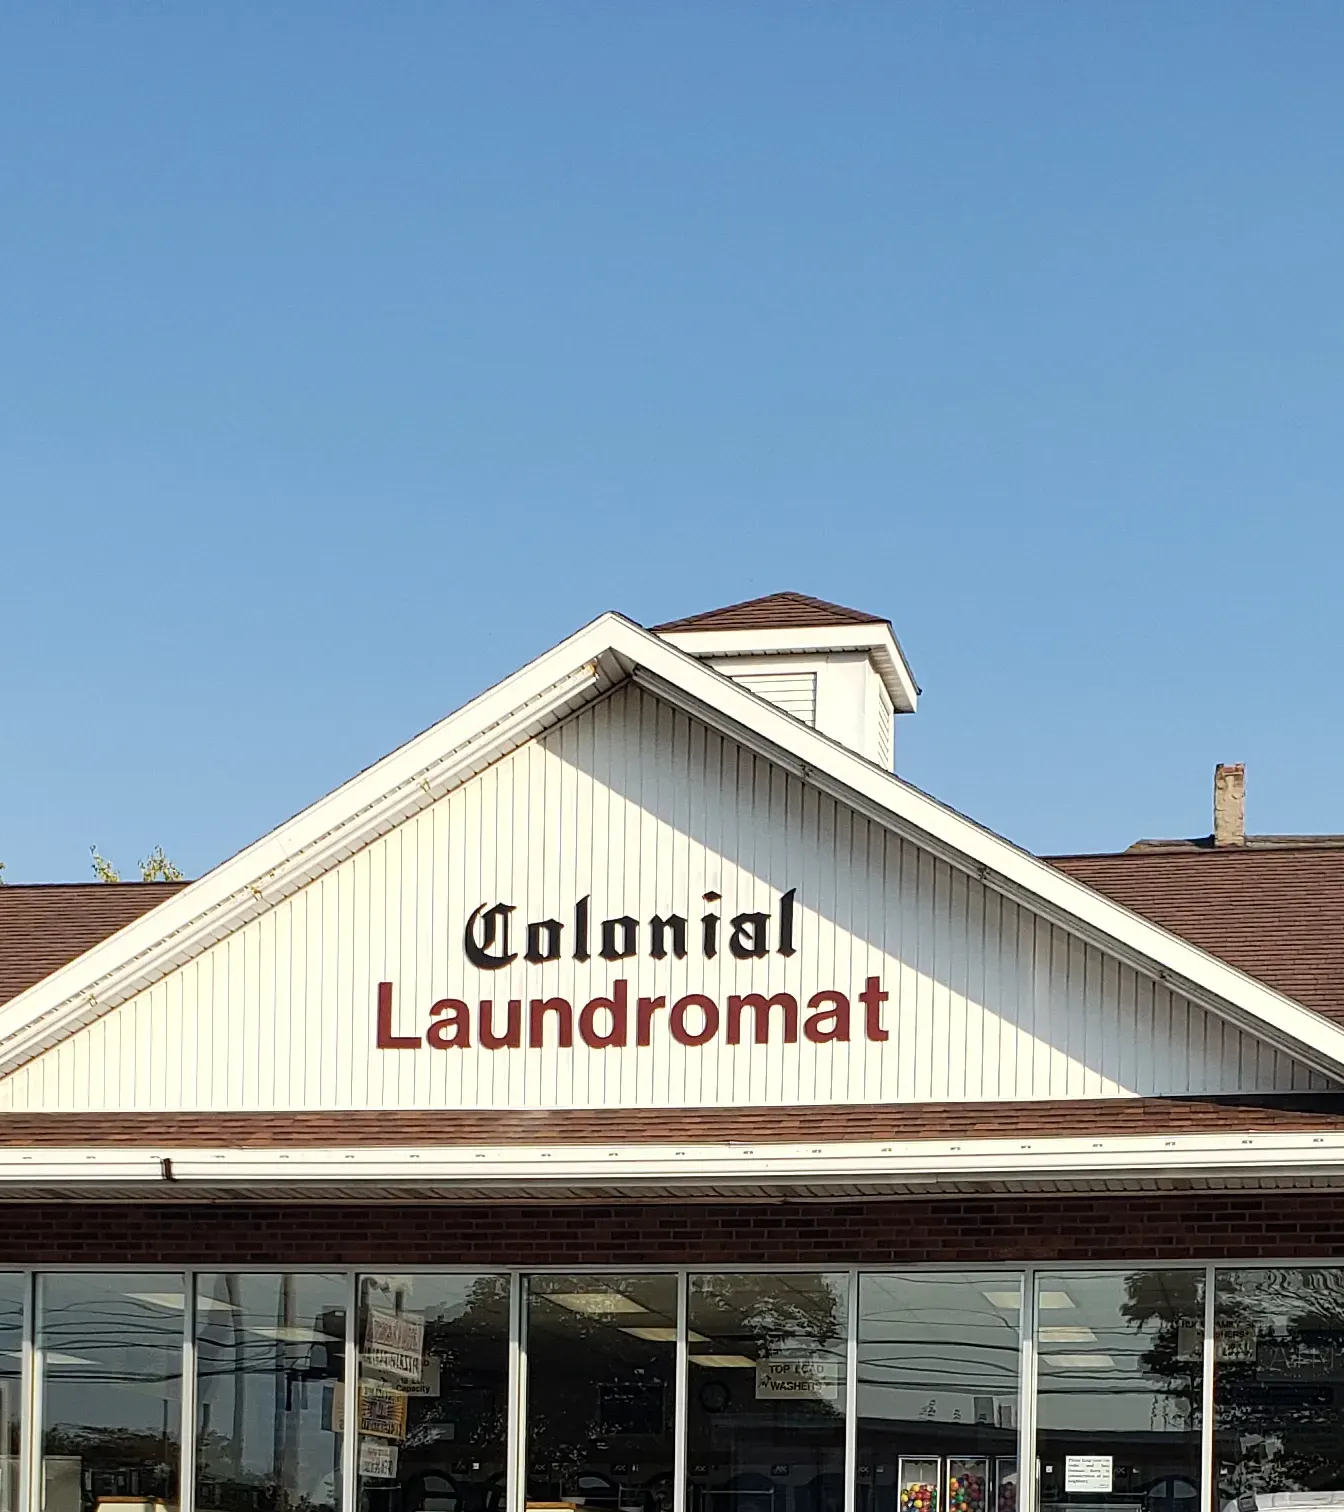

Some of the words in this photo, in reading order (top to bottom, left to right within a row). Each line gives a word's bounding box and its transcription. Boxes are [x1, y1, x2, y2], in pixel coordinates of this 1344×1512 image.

[464, 887, 797, 970] Colonial
[376, 976, 890, 1049] Laundromat
[769, 1365, 790, 1374] TOP
[396, 1385, 430, 1393] Capacity
[771, 1381, 822, 1391] WASHERS
